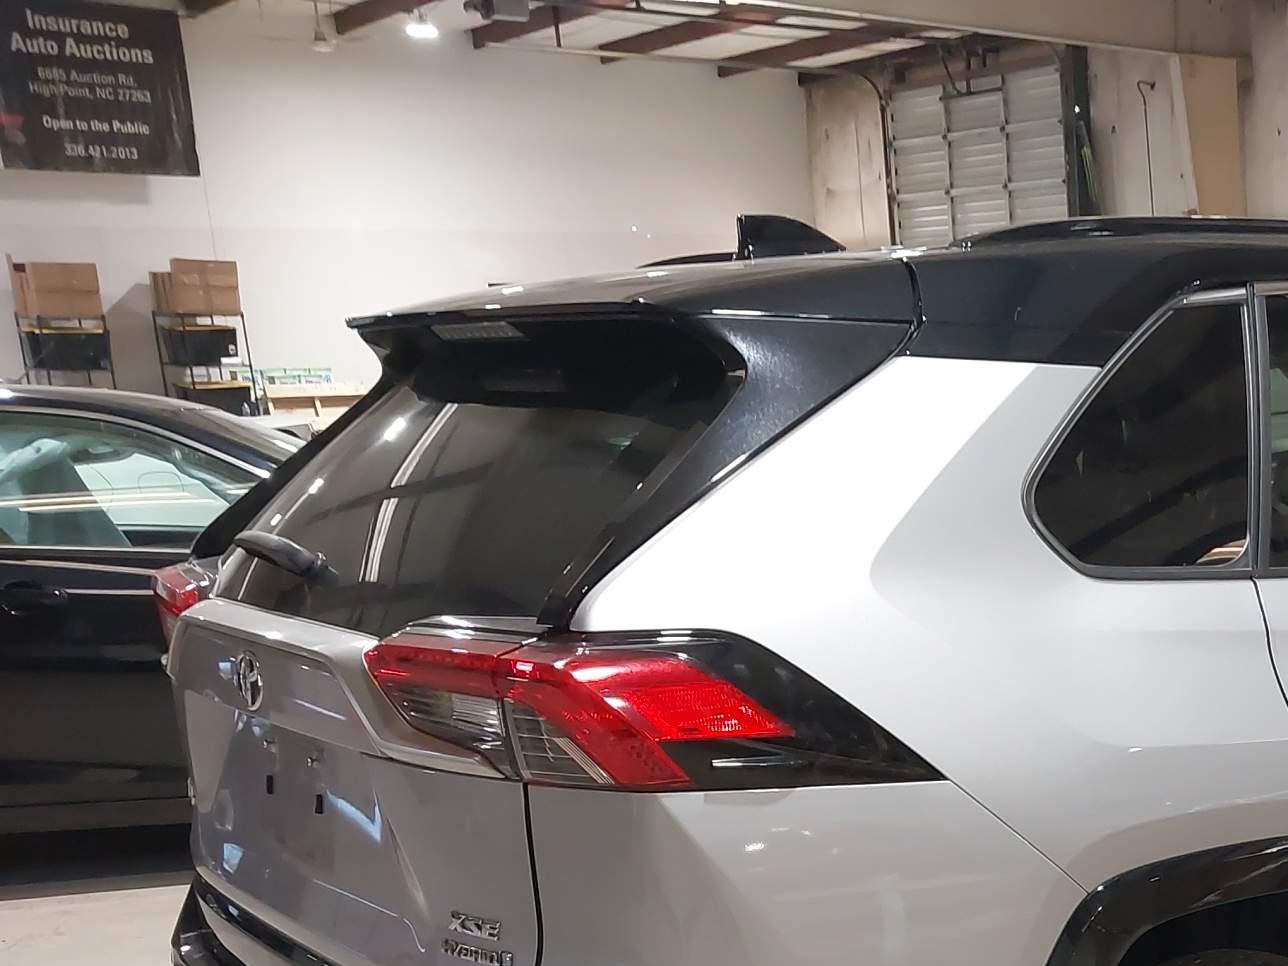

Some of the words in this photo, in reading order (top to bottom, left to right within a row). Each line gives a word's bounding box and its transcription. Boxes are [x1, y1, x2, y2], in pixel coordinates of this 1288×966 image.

[25, 8, 129, 39] Insurance
[10, 32, 59, 56] Auto
[65, 37, 154, 64] Auctions
[70, 70, 115, 84] Auction
[28, 81, 58, 97] High
[96, 87, 115, 100] NC
[42, 114, 74, 131] Open
[76, 118, 89, 131] to
[90, 119, 110, 132] the
[112, 119, 150, 135] Public
[448, 910, 502, 941] XSE
